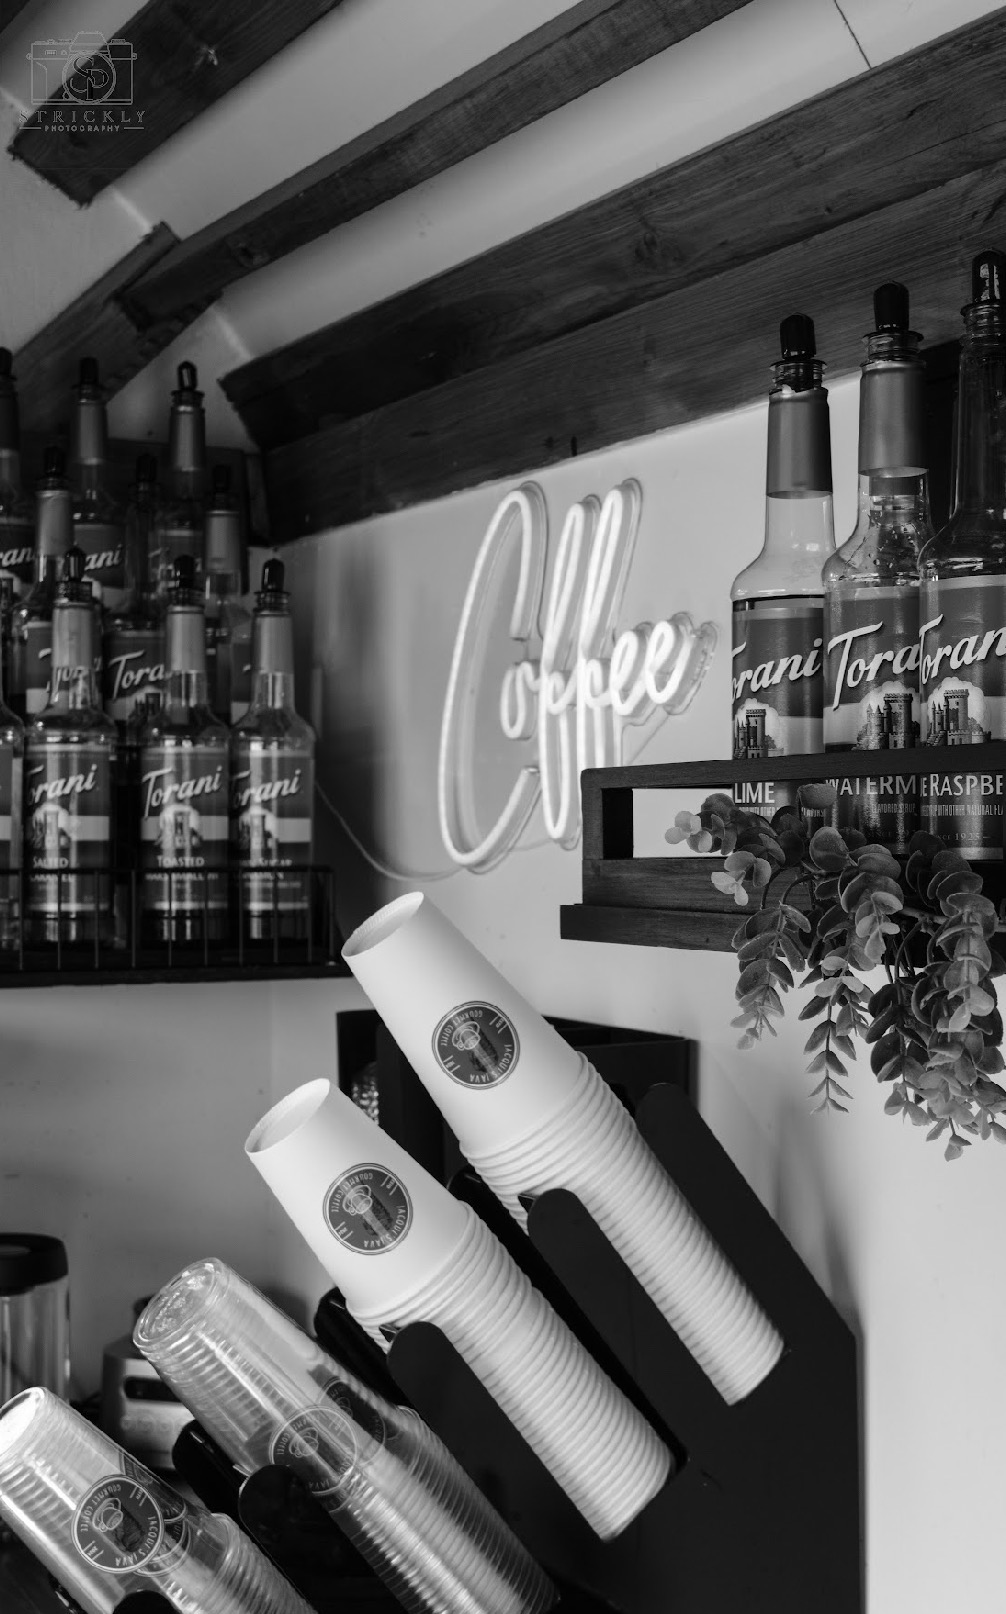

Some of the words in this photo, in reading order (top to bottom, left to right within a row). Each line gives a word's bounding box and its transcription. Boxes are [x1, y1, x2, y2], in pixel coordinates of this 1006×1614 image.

[438, 482, 708, 868] Coffee
[142, 765, 224, 819] Torani
[734, 782, 775, 804] LIME
